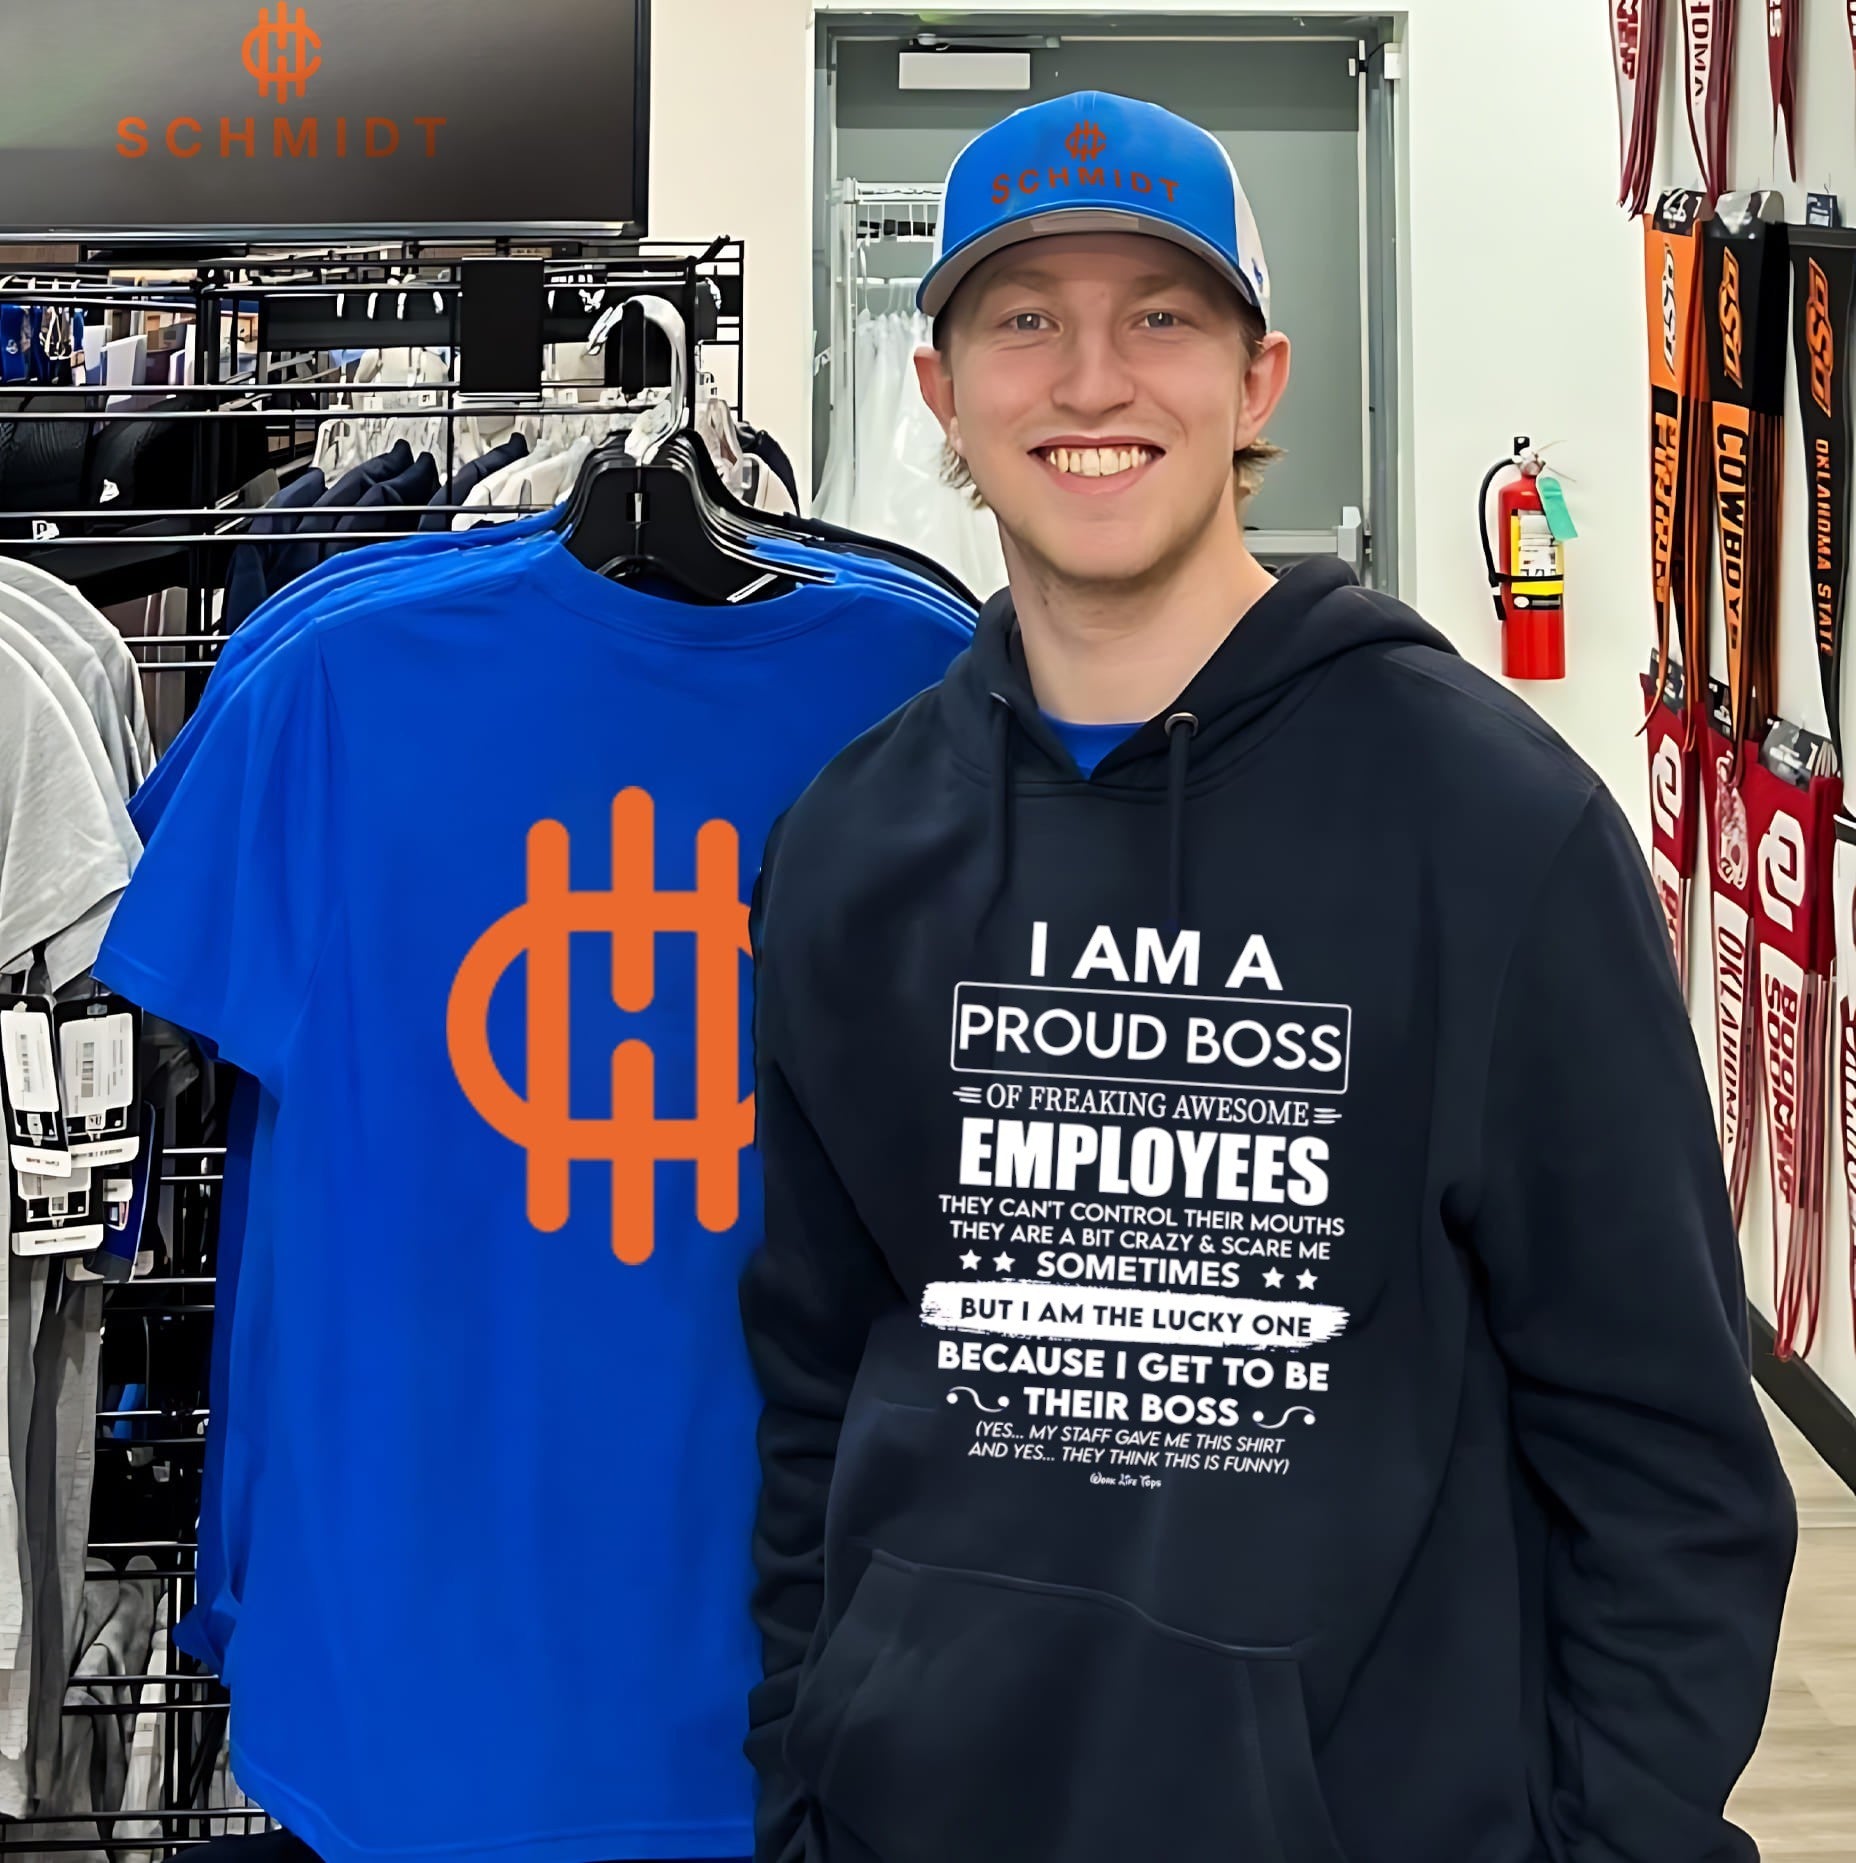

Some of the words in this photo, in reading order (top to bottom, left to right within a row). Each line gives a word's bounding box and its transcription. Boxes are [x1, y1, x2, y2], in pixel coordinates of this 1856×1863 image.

[115, 116, 448, 158] SCHMIDT
[991, 167, 1180, 206] SCHMIDT
[1815, 438, 1832, 570] OKLAHOMA
[1031, 922, 1047, 977] I
[1071, 925, 1200, 986] AM
[1225, 934, 1283, 990] A
[959, 1003, 1168, 1061] PROUD
[1186, 1017, 1342, 1073] BOSS
[986, 1082, 1023, 1109] OF
[1028, 1086, 1167, 1119] FREAKING
[1171, 1094, 1310, 1127] AWESOME
[959, 1116, 1330, 1207] EMPLOYEES
[938, 1194, 994, 1215] THEY
[998, 1198, 1066, 1220] CAN'T
[1069, 1203, 1179, 1227] CONTROL
[1183, 1209, 1244, 1231] THEIR
[1250, 1213, 1345, 1237] MOUTHS
[949, 1220, 1005, 1241] THEY
[1010, 1225, 1054, 1245] ARE
[1058, 1228, 1076, 1245] A
[1081, 1228, 1115, 1248] BIT
[1119, 1230, 1194, 1252] CRAZY
[1198, 1234, 1216, 1254] &
[1220, 1237, 1293, 1259] SCARE
[1298, 1241, 1331, 1261] ME
[1036, 1250, 1241, 1289] SOMETIMES
[961, 1297, 1013, 1320] BUT
[1021, 1301, 1029, 1321] I
[1039, 1302, 1084, 1324] AM
[1093, 1305, 1143, 1328] THE
[1153, 1308, 1244, 1334] LUCKY
[1251, 1314, 1312, 1338] ONE
[937, 1340, 1106, 1379] BECAUSE
[1116, 1350, 1127, 1380] I
[1137, 1352, 1213, 1385] GET
[1222, 1356, 1275, 1389] TO
[1285, 1360, 1330, 1392] BE
[1023, 1386, 1130, 1421] THEIR
[1140, 1392, 1240, 1427] BOSS
[975, 1420, 1024, 1440] (YES...
[1028, 1424, 1059, 1441] MY
[1060, 1426, 1113, 1444] STAFF
[1114, 1429, 1162, 1447] GAVE
[1163, 1432, 1192, 1449] ME
[1196, 1433, 1233, 1451] THIS
[1235, 1436, 1286, 1454] SHIRT
[967, 1441, 1009, 1459] AND
[1013, 1443, 1056, 1462] YES...
[1062, 1446, 1106, 1464] THEY
[1109, 1449, 1160, 1467] THINK
[1164, 1451, 1201, 1470] THIS
[1203, 1454, 1221, 1471] IS
[1223, 1455, 1290, 1476] FUNNY)
